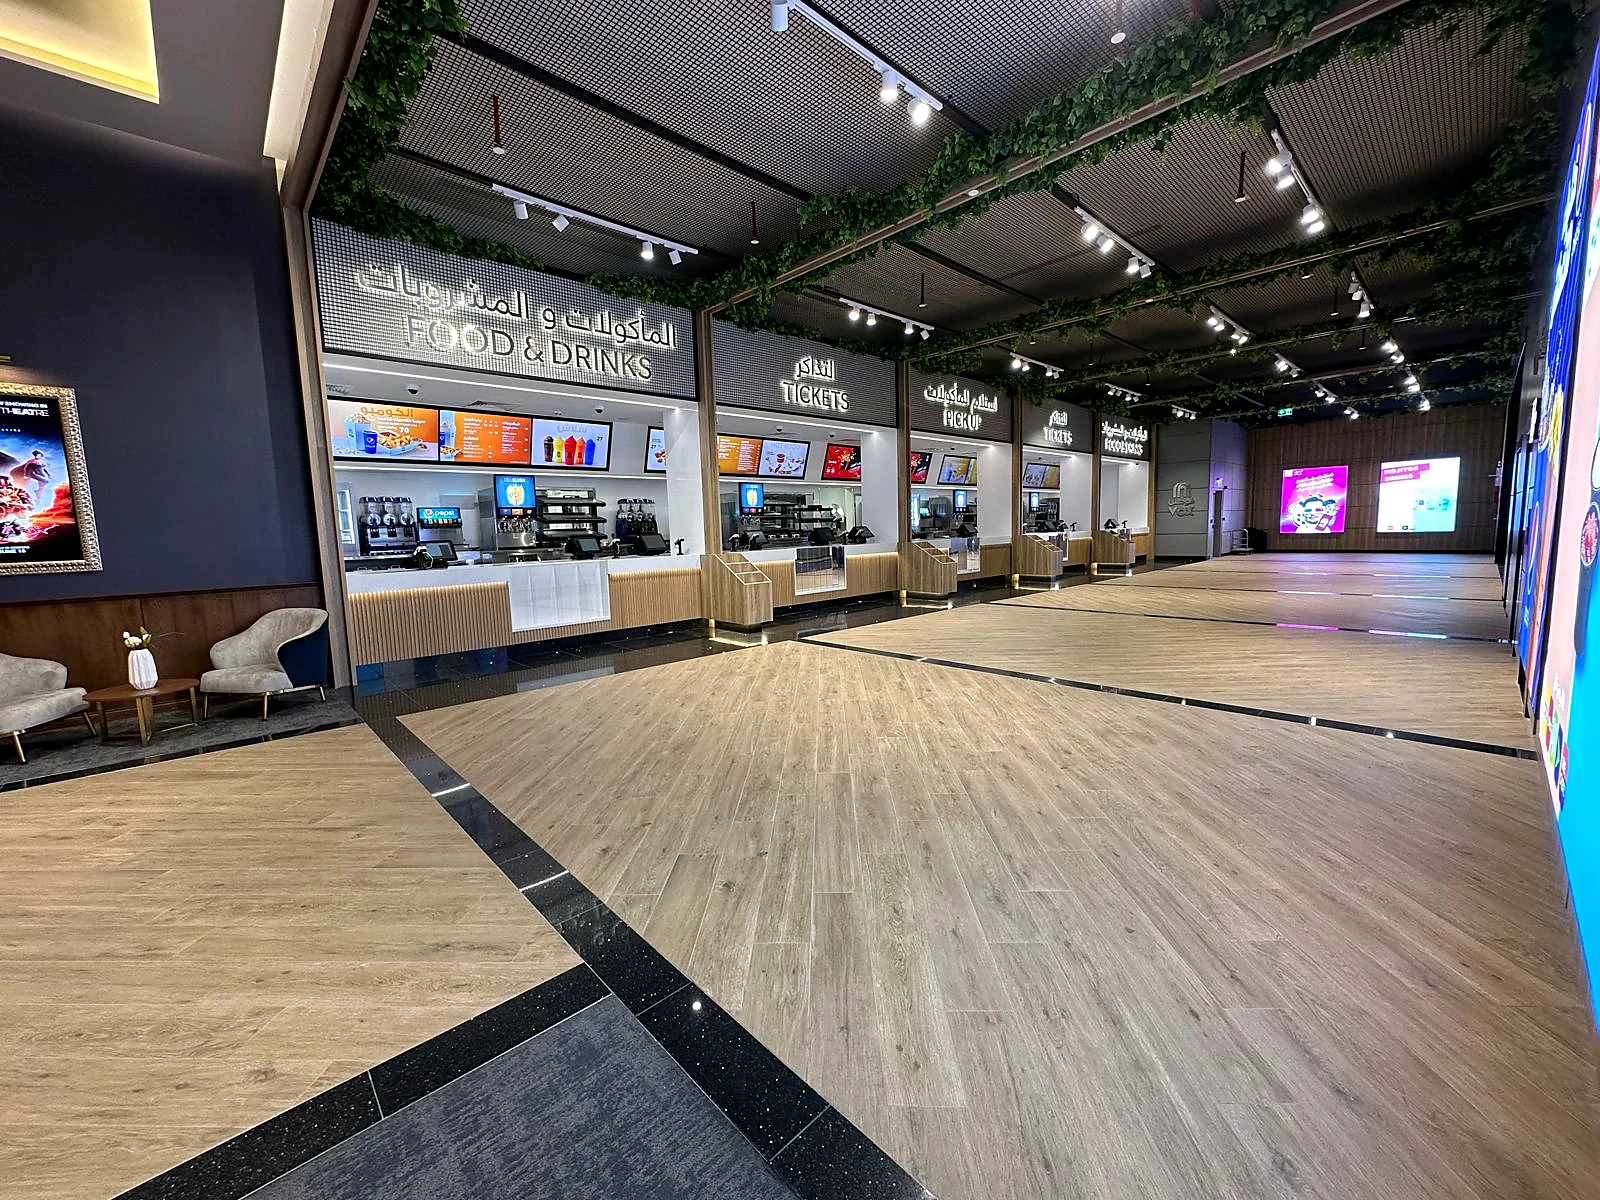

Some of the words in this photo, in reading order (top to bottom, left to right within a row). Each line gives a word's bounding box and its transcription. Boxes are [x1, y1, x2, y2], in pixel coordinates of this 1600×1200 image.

[357, 263, 531, 320] المشروبات
[542, 307, 556, 330] و
[565, 308, 678, 348] المأكولات
[406, 314, 515, 356] FOOD
[523, 335, 545, 363] &
[550, 339, 652, 380] DRINKS
[795, 355, 837, 379] التذاكر
[781, 381, 850, 411] TICKETS
[360, 406, 414, 418] الكومبو
[1043, 426, 1073, 445] TICKETS
